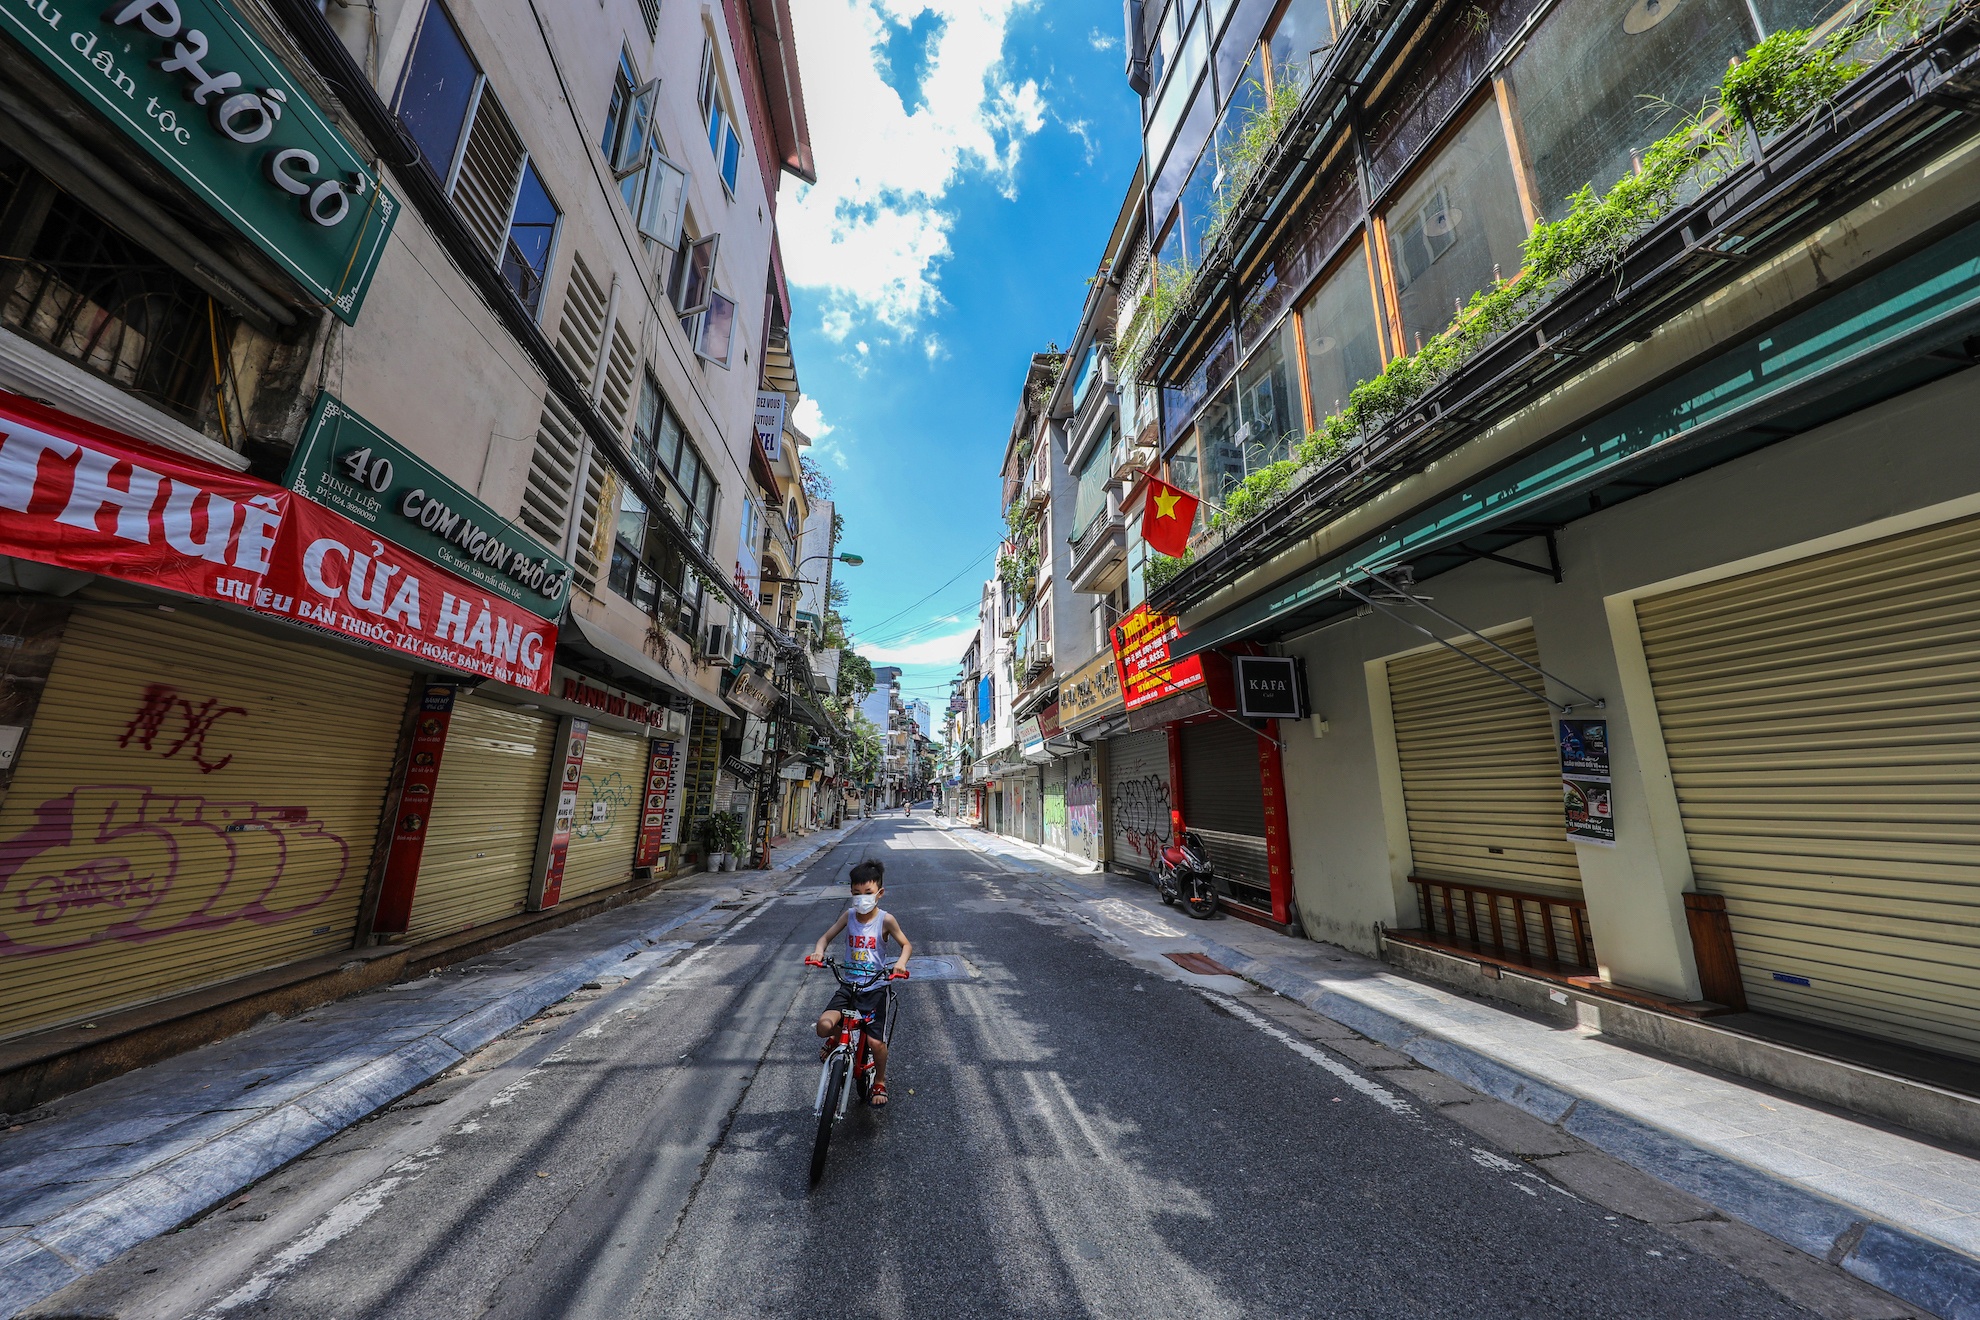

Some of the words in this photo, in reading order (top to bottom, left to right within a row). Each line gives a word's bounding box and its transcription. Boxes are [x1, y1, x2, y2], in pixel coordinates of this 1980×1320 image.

[70, 31, 137, 100] dân
[145, 96, 191, 146] tộc
[767, 397, 781, 409] VOUS
[345, 447, 394, 493] 40
[354, 491, 382, 514] LIỆT
[0, 416, 282, 577] THUÊ
[303, 537, 422, 630] CỬA
[433, 591, 544, 671] HÀNG
[403, 488, 460, 540] CƠM
[454, 519, 512, 570] NGON
[509, 552, 549, 590] PHỐ
[438, 546, 454, 563] Các
[454, 558, 470, 573] món
[471, 566, 485, 580] xào
[485, 574, 497, 587] nấu
[498, 580, 511, 594] dân
[511, 588, 522, 600] tộc
[216, 576, 252, 601] ƯU
[298, 600, 337, 627] BÁN
[341, 613, 394, 644] THUỐC
[396, 630, 423, 653] TÂY
[422, 642, 457, 665] HOẶC
[457, 653, 480, 671] BÁN
[481, 659, 494, 675] VÉ
[515, 673, 533, 687] BAY
[562, 675, 608, 712] BÁNH
[1249, 679, 1286, 691] KAFA
[574, 721, 586, 730] 38
[729, 759, 753, 776] HOTE
